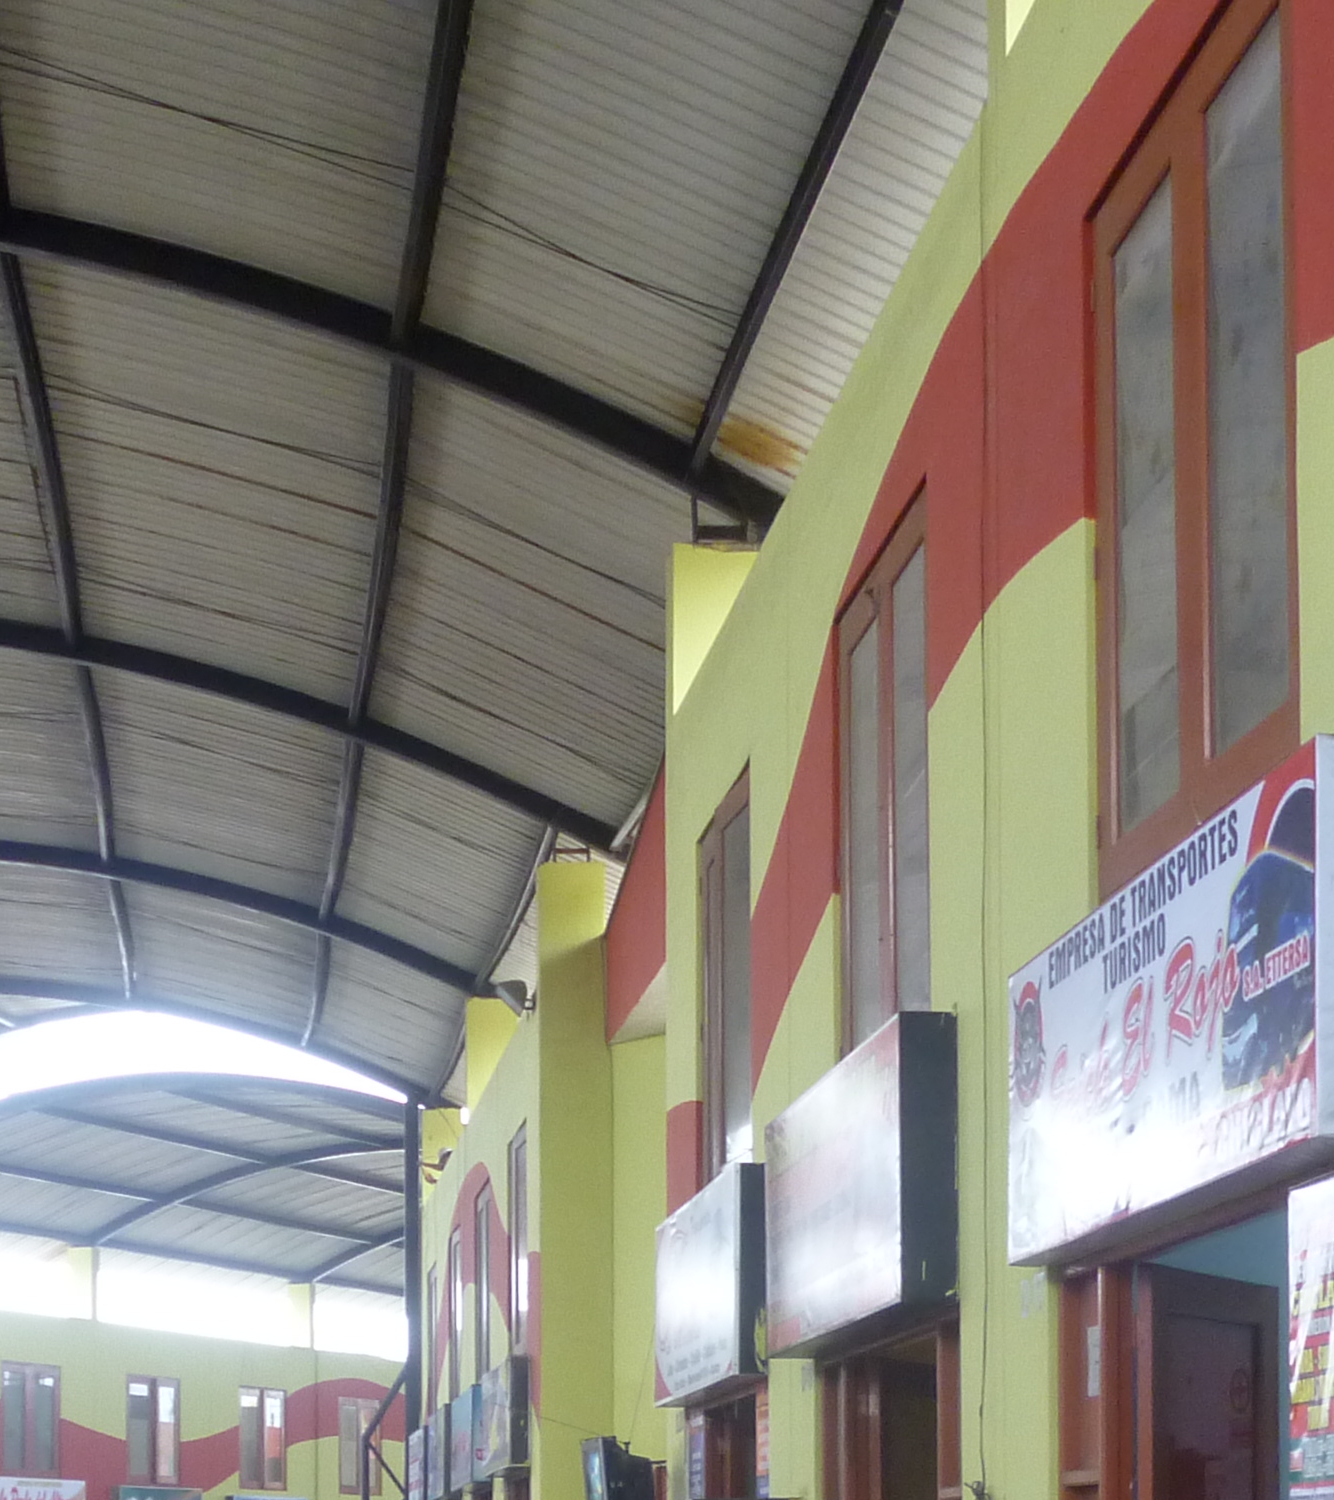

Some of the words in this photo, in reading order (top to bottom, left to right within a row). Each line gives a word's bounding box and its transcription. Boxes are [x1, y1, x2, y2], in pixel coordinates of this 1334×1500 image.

[1048, 913, 1105, 990] EMPRESA
[1110, 901, 1125, 944] DE
[1130, 809, 1238, 928] TRANSPORTES
[1102, 913, 1166, 994] TURISMO
[1122, 974, 1155, 1099] El
[1165, 930, 1241, 1060] Rojo
